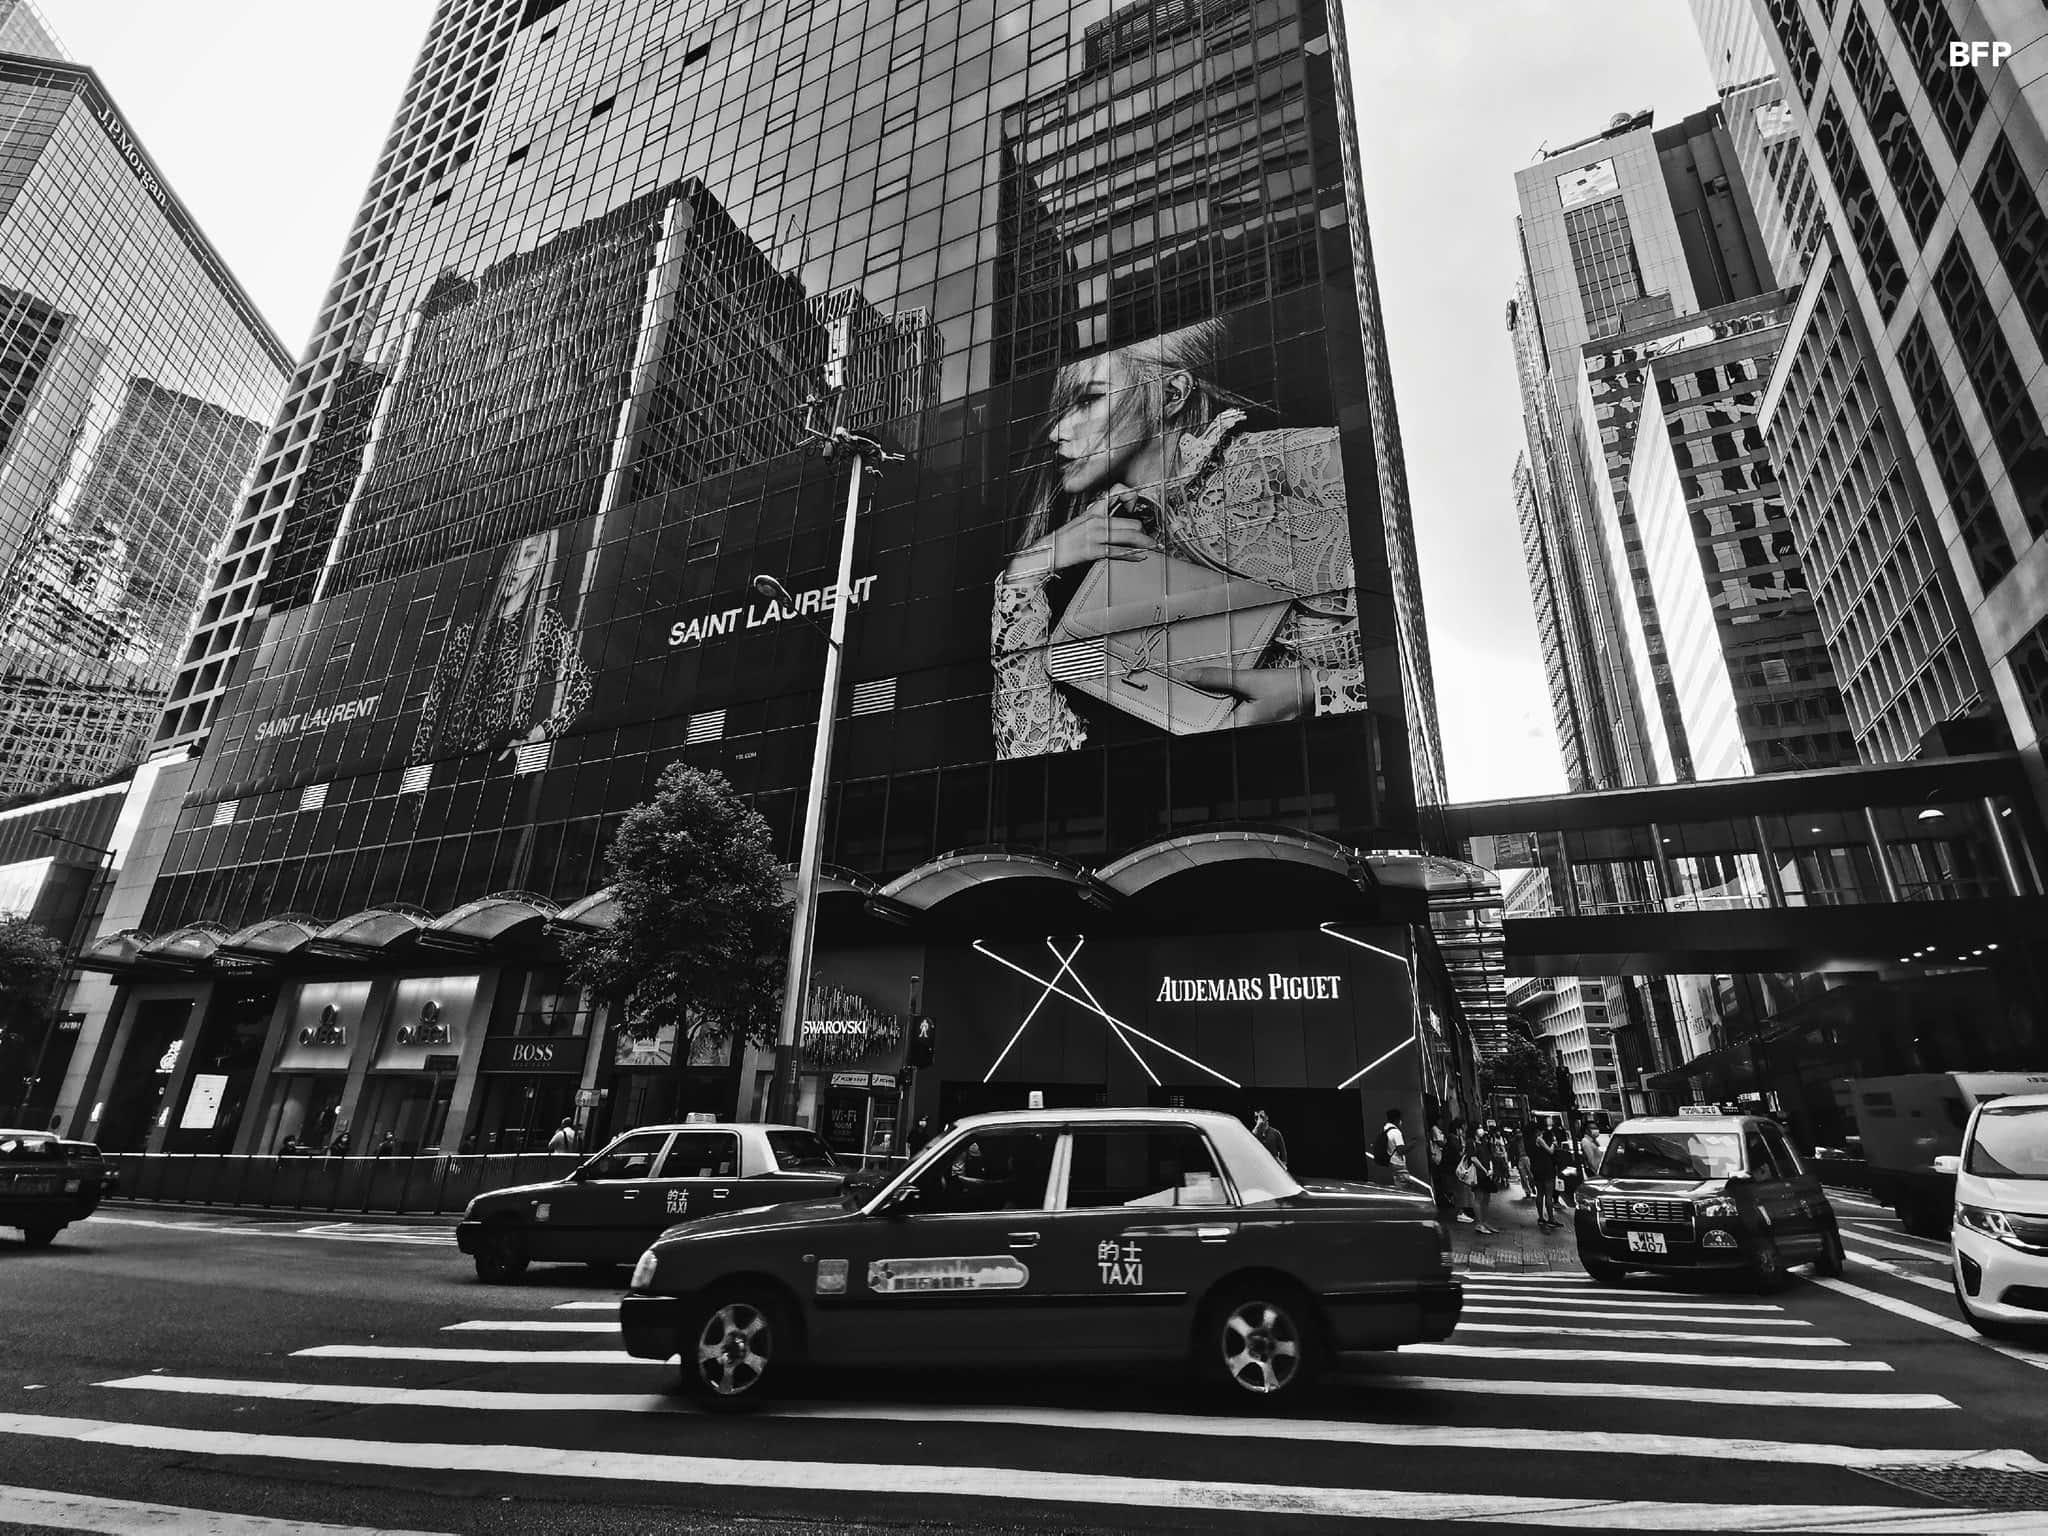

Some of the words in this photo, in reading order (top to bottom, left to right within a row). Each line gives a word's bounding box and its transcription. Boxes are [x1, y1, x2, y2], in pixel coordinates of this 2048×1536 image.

[97, 107, 167, 207] J.P.Morgan
[668, 607, 743, 646] SAINT
[745, 574, 878, 629] LAURENT
[254, 713, 301, 742] SAINT
[300, 695, 379, 731] LAURENT
[803, 1020, 866, 1035] SWAROVSKI
[512, 1044, 554, 1061] BOSS
[667, 1188, 689, 1201] 的士
[666, 1201, 688, 1214] TAXI
[1637, 1232, 1655, 1243] WH
[1098, 1240, 1143, 1262] 的士
[1098, 1262, 1143, 1286] TAXI
